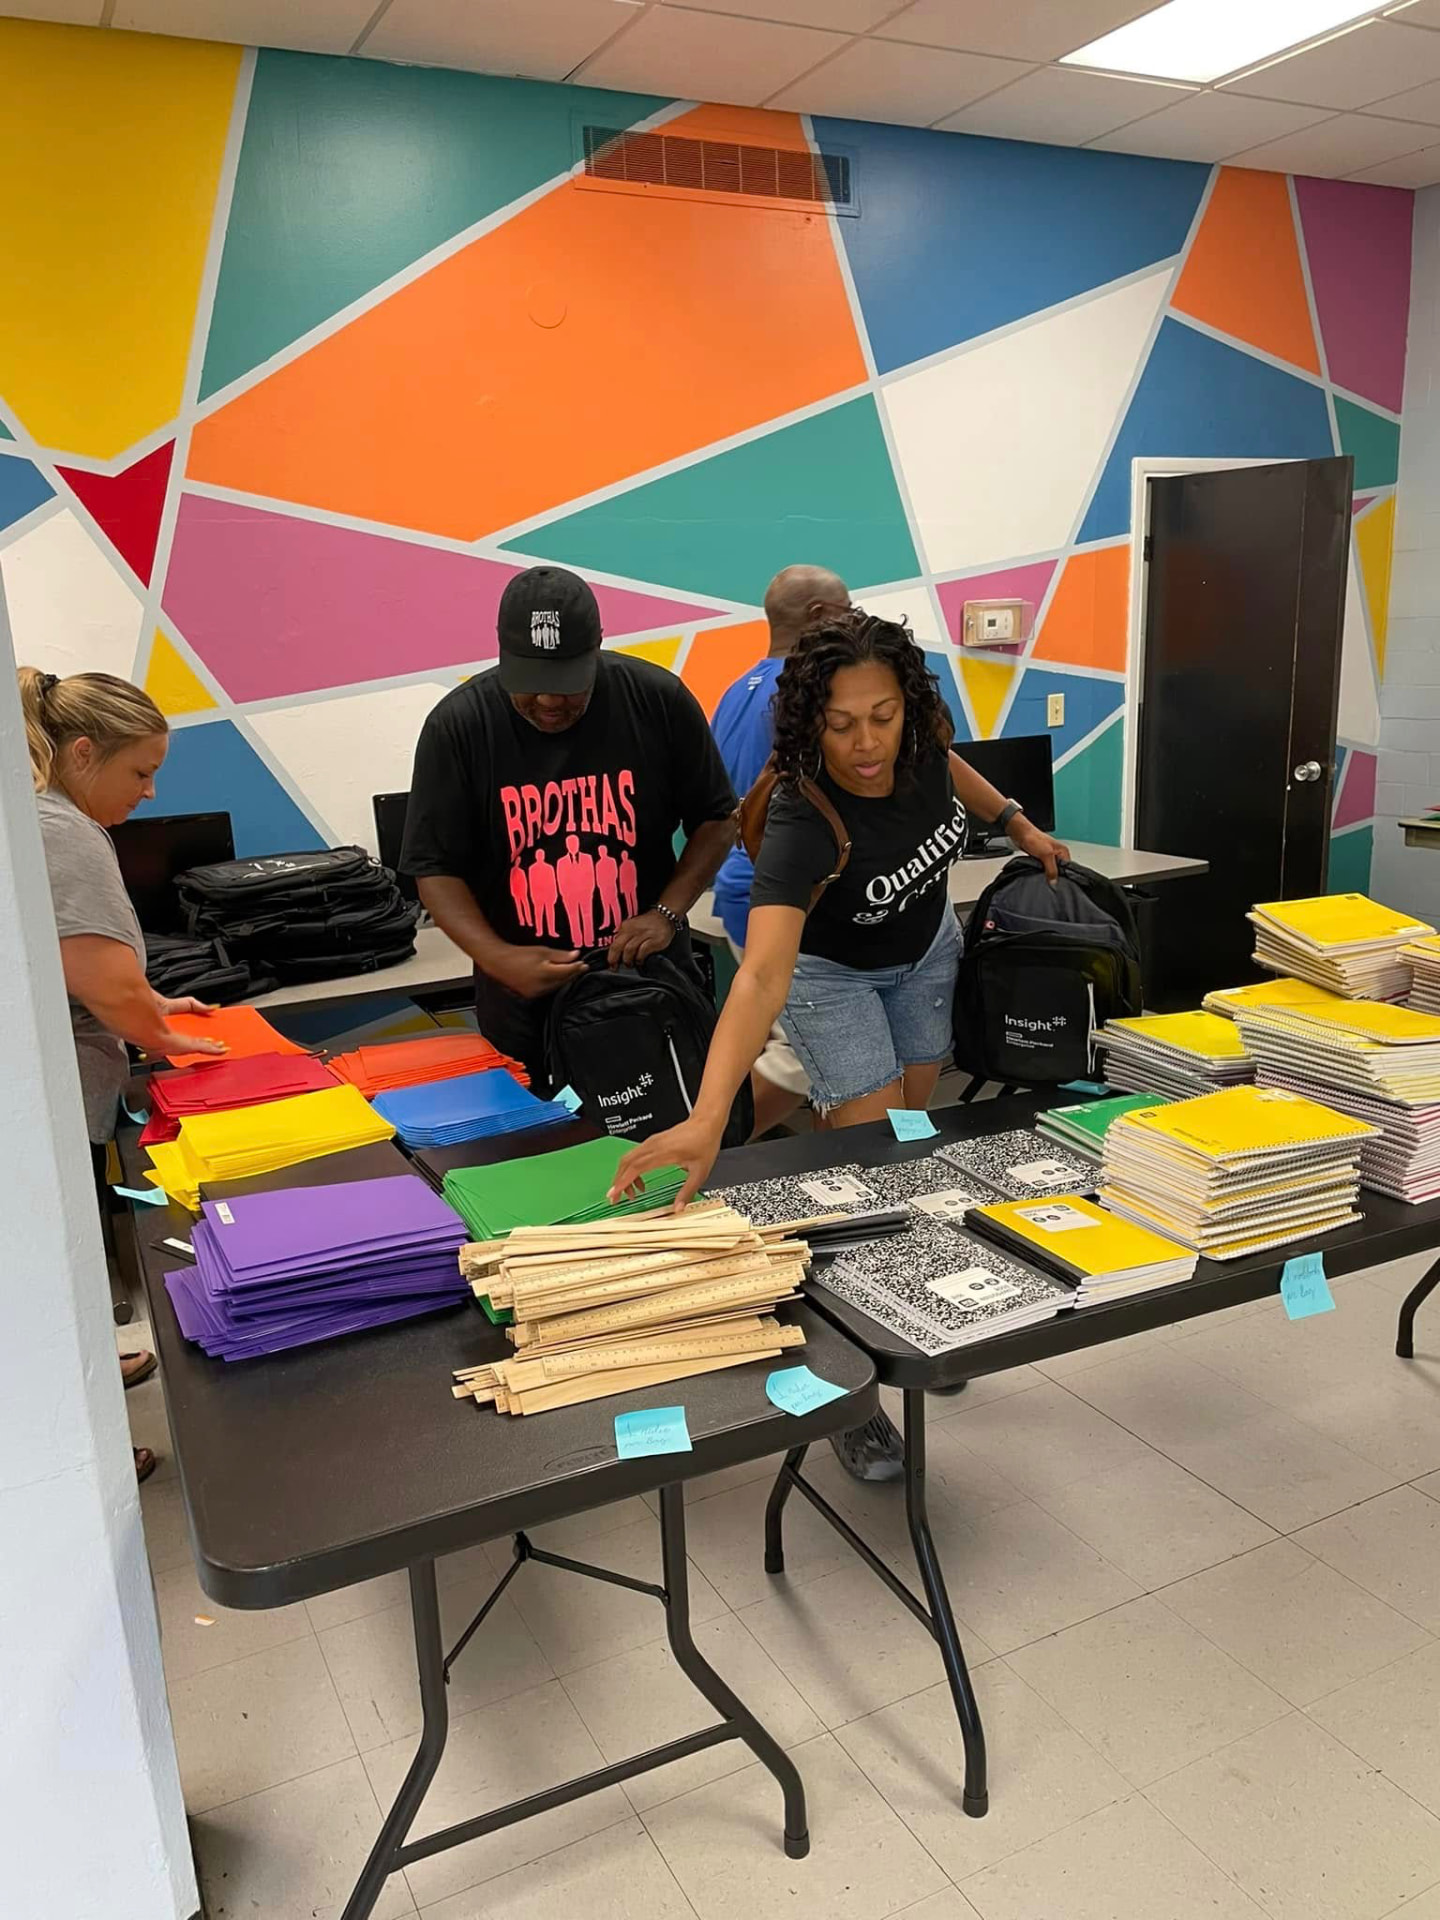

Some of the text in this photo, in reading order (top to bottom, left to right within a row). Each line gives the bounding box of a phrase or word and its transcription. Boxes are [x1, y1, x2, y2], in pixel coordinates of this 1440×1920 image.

[531, 610, 560, 628] BROTHAS
[500, 769, 637, 863] BROTHAS
[866, 795, 966, 906] Qualified
